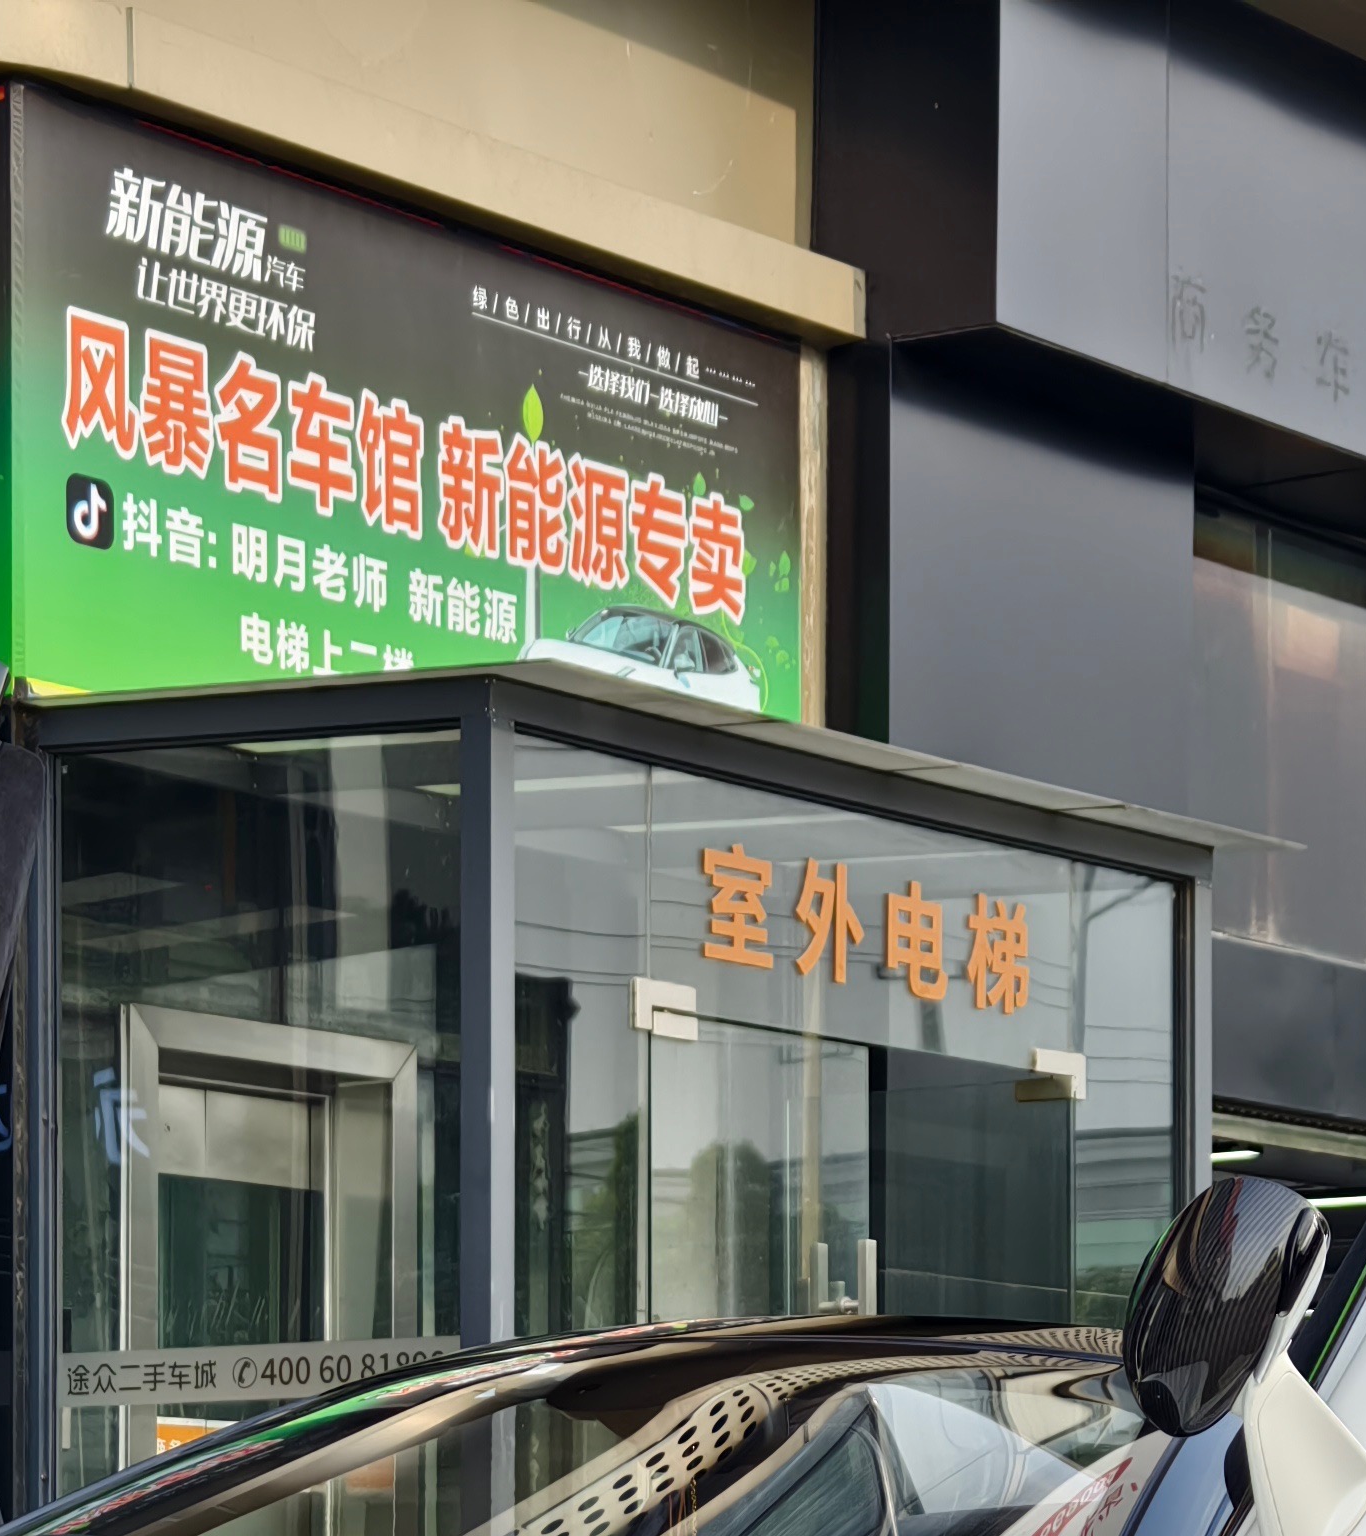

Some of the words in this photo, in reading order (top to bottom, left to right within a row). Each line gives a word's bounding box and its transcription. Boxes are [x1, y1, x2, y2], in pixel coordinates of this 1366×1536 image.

[136, 257, 317, 352] 让世界更环保
[61, 305, 425, 540] 风暴名车馆
[438, 415, 746, 626] 新能源专卖
[408, 568, 518, 646] 新能源
[703, 843, 1031, 1015] 室外电梯
[67, 1360, 217, 1396] 途众二手车城
[261, 1356, 308, 1386] 400
[320, 1355, 352, 1384] 60
